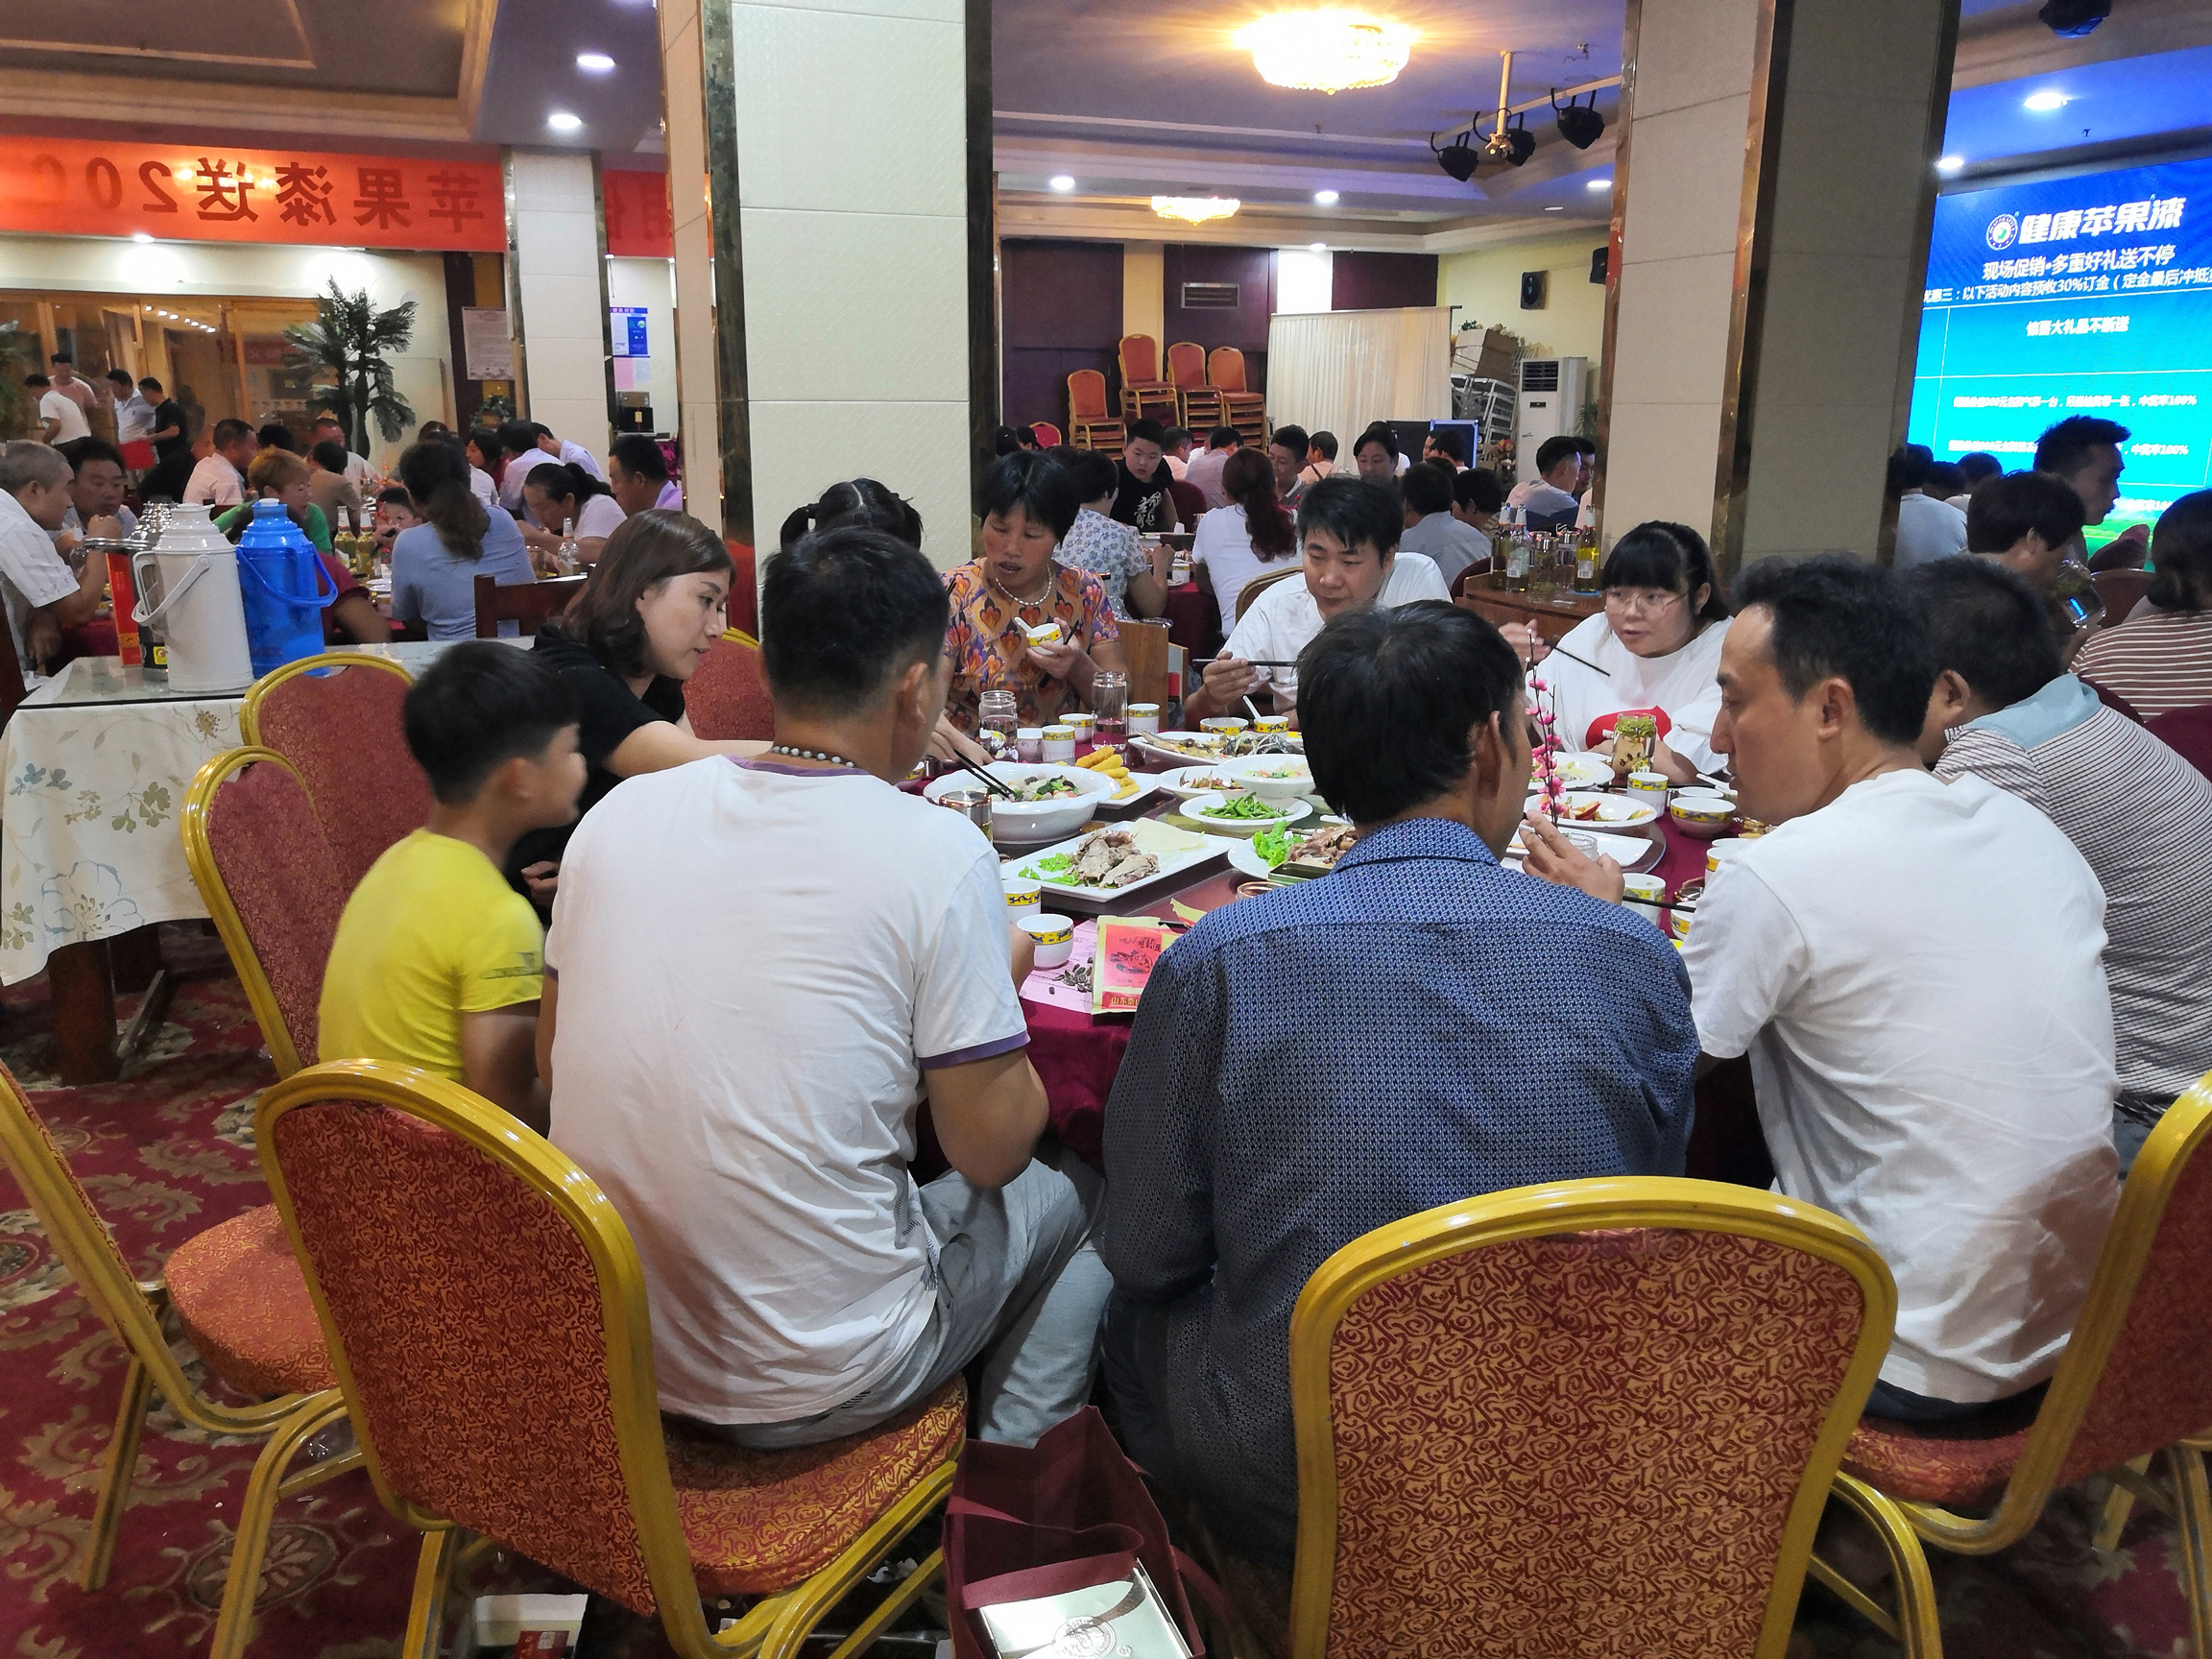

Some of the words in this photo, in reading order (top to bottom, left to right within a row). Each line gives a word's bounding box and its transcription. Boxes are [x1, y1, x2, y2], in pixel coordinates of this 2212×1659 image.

[2018, 197, 2187, 245] 健康苹果漆
